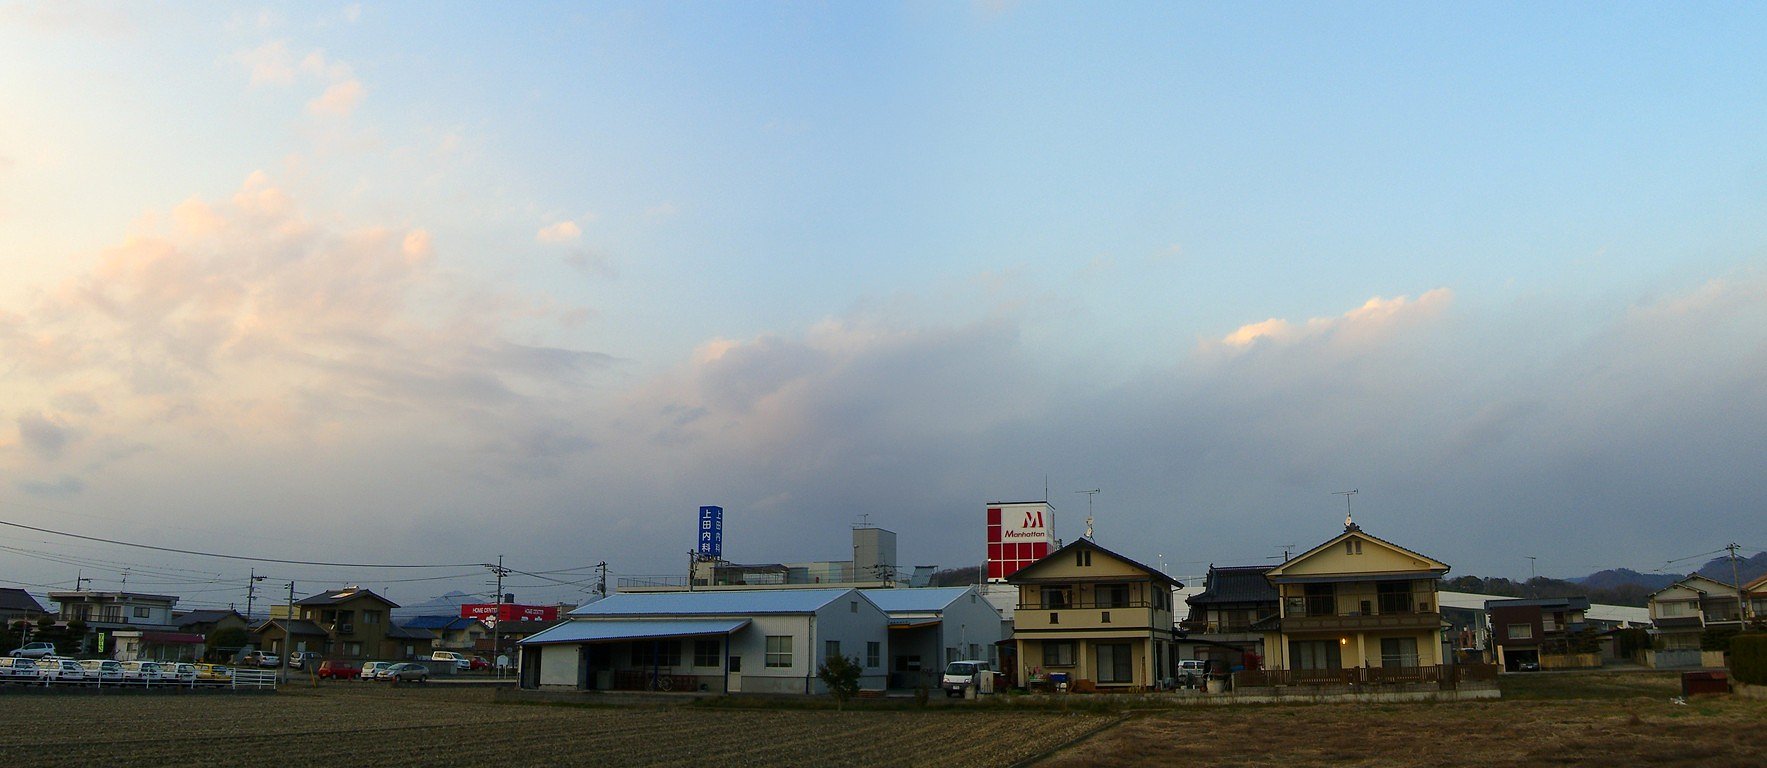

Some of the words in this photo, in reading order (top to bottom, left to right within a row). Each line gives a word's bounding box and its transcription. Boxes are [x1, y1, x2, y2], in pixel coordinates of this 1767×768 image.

[1022, 511, 1044, 529] M
[702, 509, 711, 553] 上田内科
[1004, 530, 1045, 538] Manhattan
